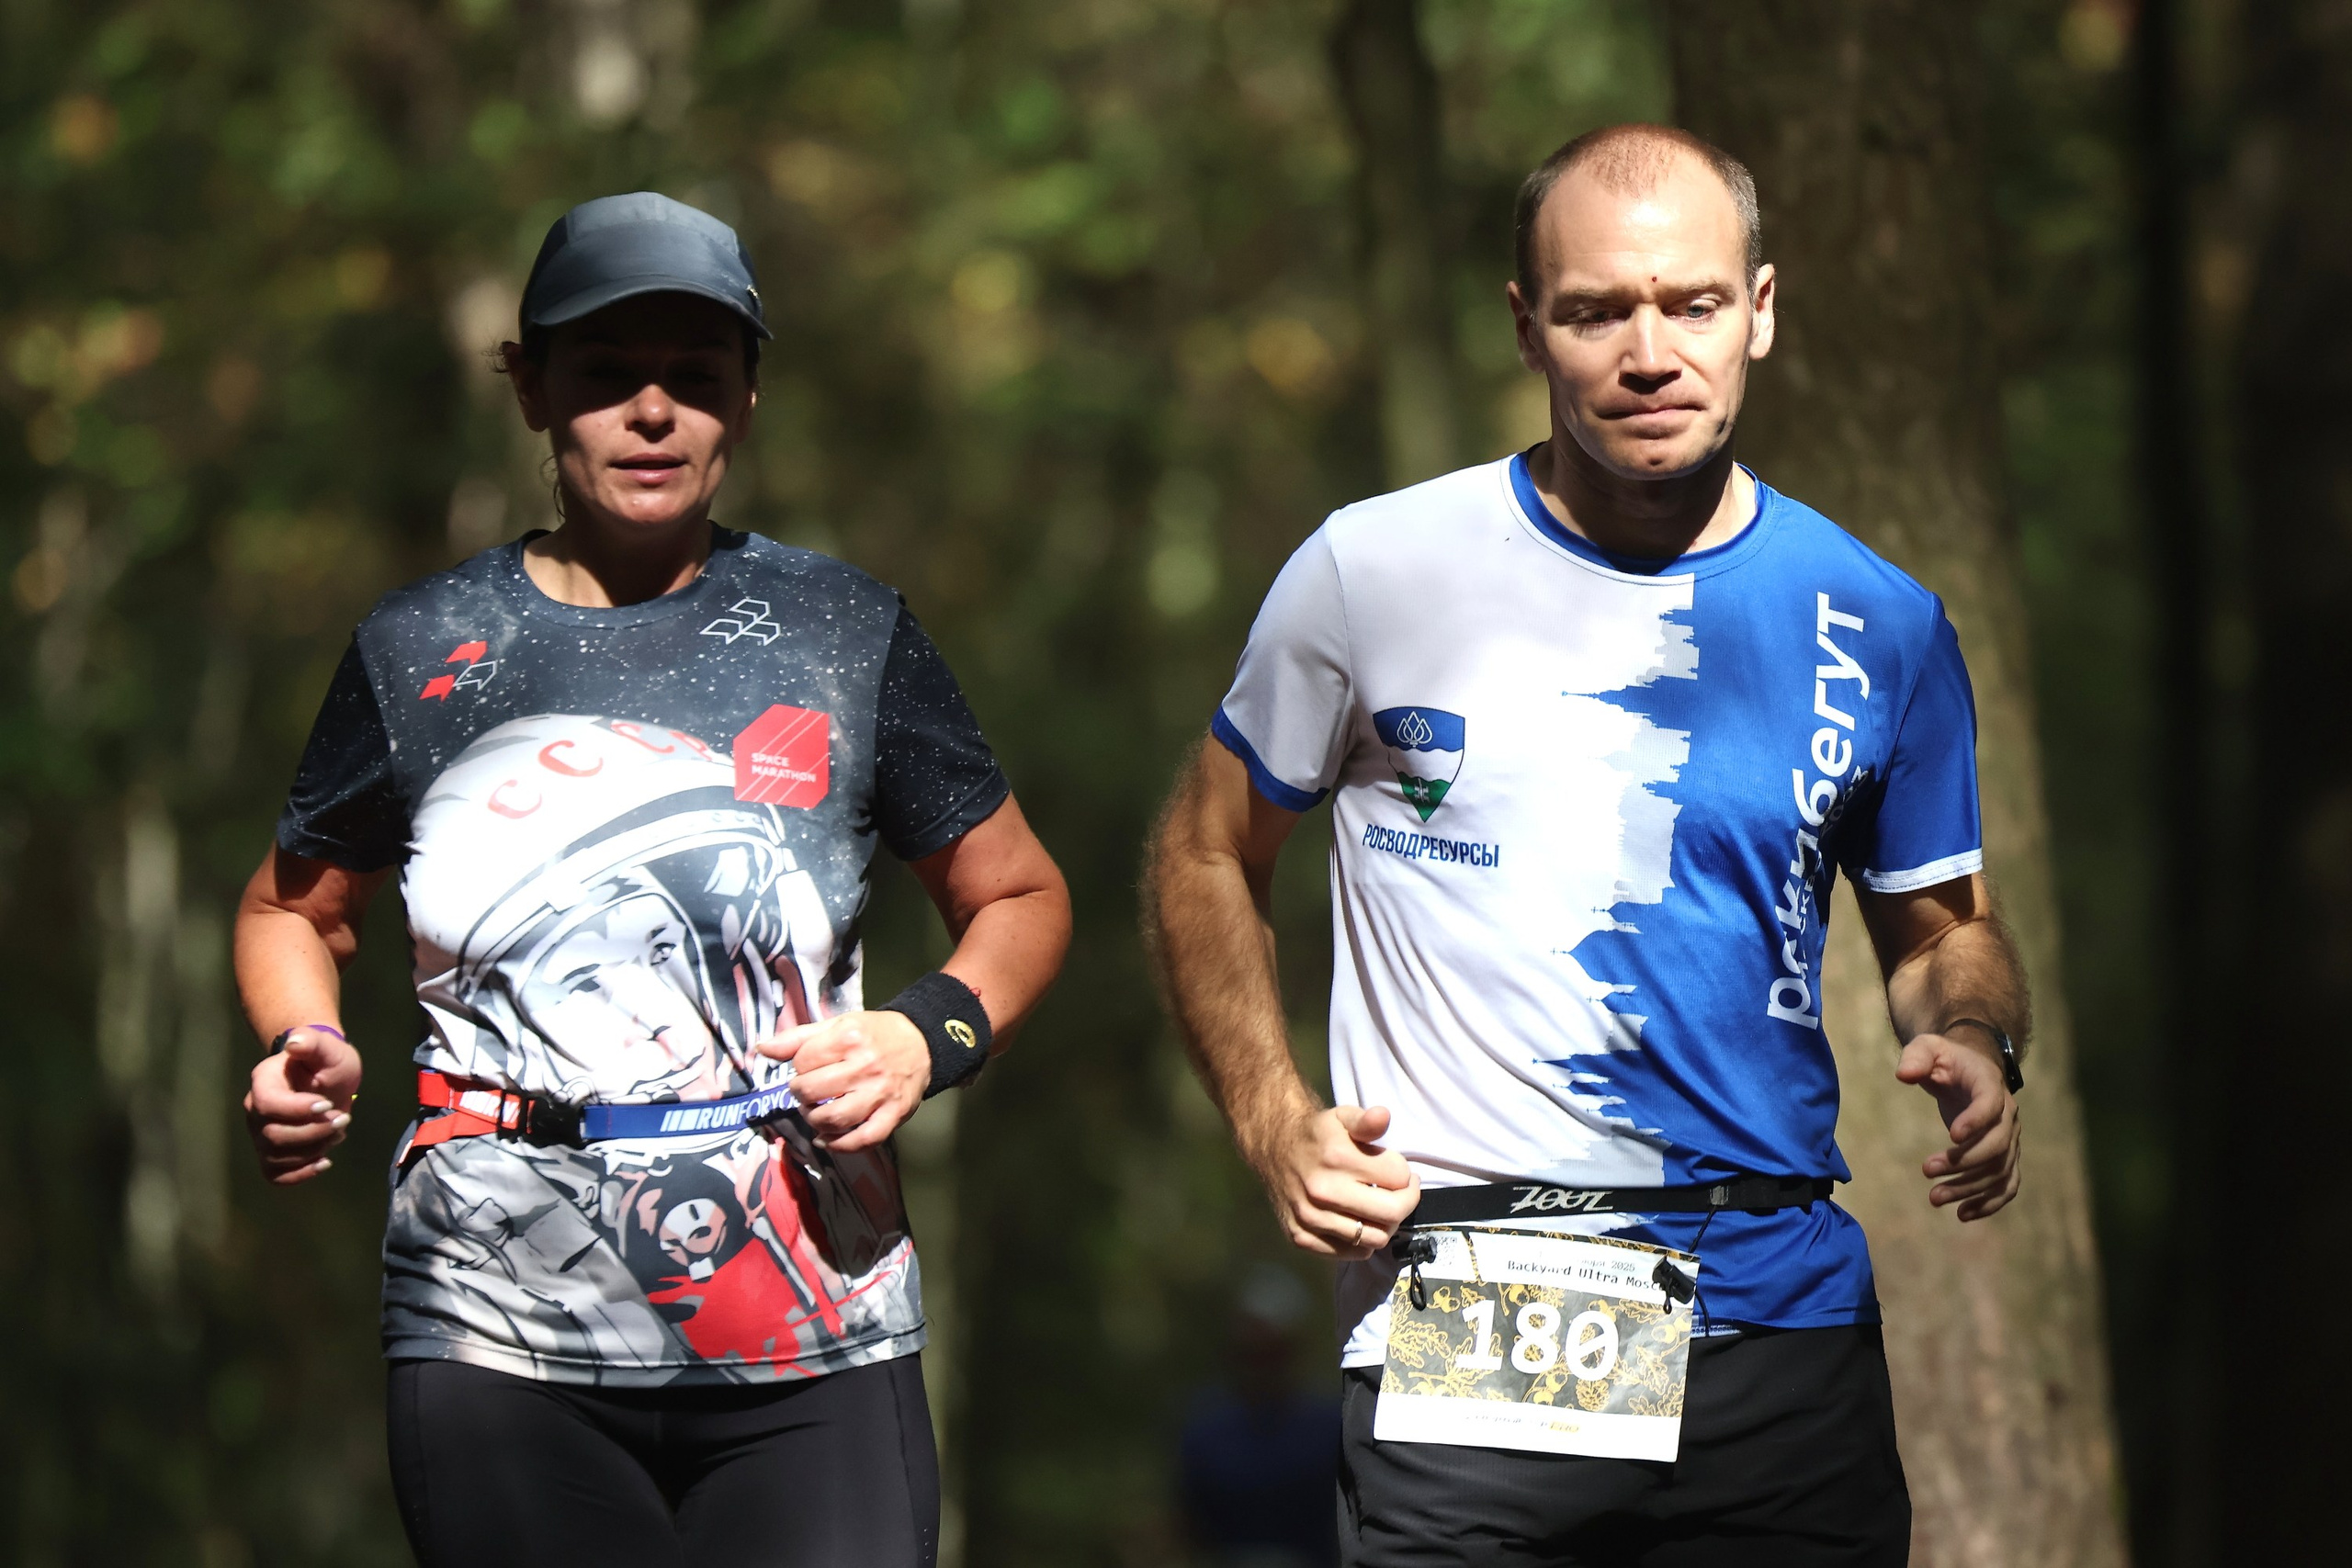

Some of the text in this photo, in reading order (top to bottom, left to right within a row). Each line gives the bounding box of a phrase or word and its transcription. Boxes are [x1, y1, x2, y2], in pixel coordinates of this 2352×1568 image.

[751, 751, 789, 768] SPACE
[751, 764, 817, 783] MARATHON
[1363, 823, 1499, 867] РОСВОДРЕСУРСЫ
[1578, 1269, 1619, 1284] Ultra
[1455, 1299, 1619, 1382] 180
